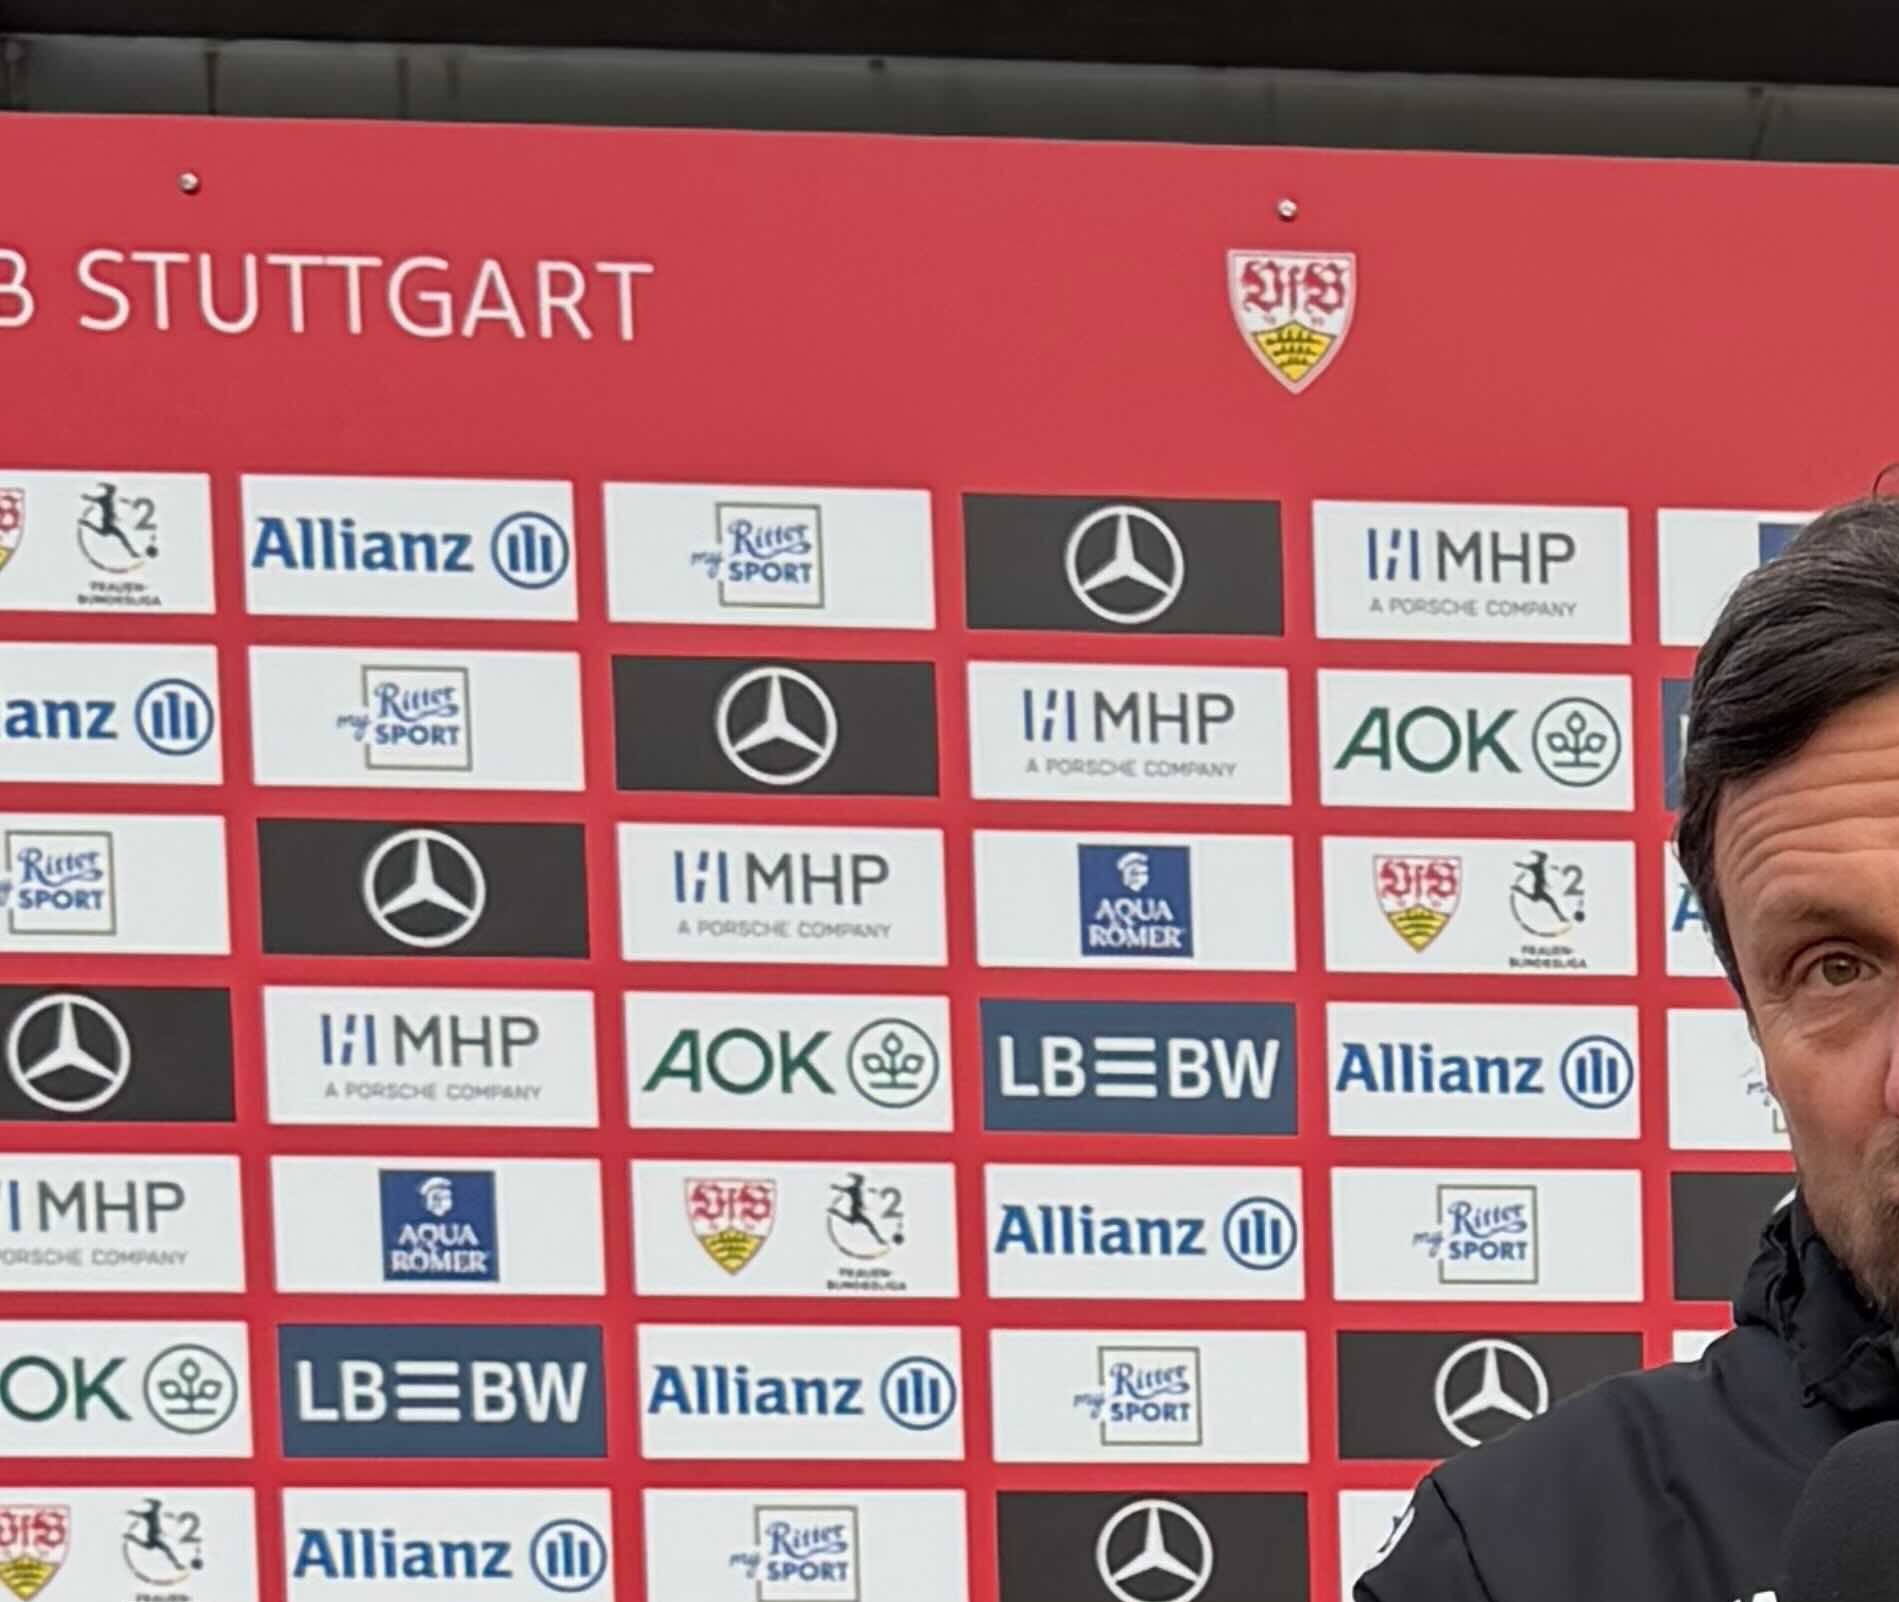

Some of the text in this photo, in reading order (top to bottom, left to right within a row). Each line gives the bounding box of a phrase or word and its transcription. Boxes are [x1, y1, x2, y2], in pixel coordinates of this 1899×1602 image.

[77, 250, 654, 341] STUTTGART
[252, 517, 474, 572] Allianz
[728, 520, 811, 560] Ritter
[1437, 531, 1575, 584] MHP
[729, 559, 812, 583] SPORT
[1389, 597, 1478, 616] PORSCHE
[1486, 600, 1576, 617] COMPANY
[374, 682, 459, 723] Ritter
[1094, 691, 1234, 744] MHP
[376, 721, 460, 745] SPORT
[1334, 706, 1521, 773] AOK
[1046, 758, 1136, 777] PORSCHE
[1144, 760, 1236, 777] COMPANY
[19, 885, 104, 910] SPORT
[746, 853, 888, 905] MHP
[1096, 898, 1173, 924] AQUA
[394, 1015, 538, 1067] MHP
[642, 1028, 835, 1094] AOK
[1336, 1043, 1544, 1094] Allianz
[38, 1181, 184, 1233] MHP
[1448, 1201, 1527, 1239] Ritter
[399, 1223, 478, 1249] AQUA
[995, 1204, 1206, 1255] Allianz
[1449, 1237, 1527, 1260] SPORT
[648, 1365, 863, 1415] Allianz
[1110, 1363, 1190, 1400] Ritter
[1111, 1399, 1190, 1422] SPORT
[294, 1528, 512, 1578] Allianz
[767, 1558, 848, 1581] SPORT
